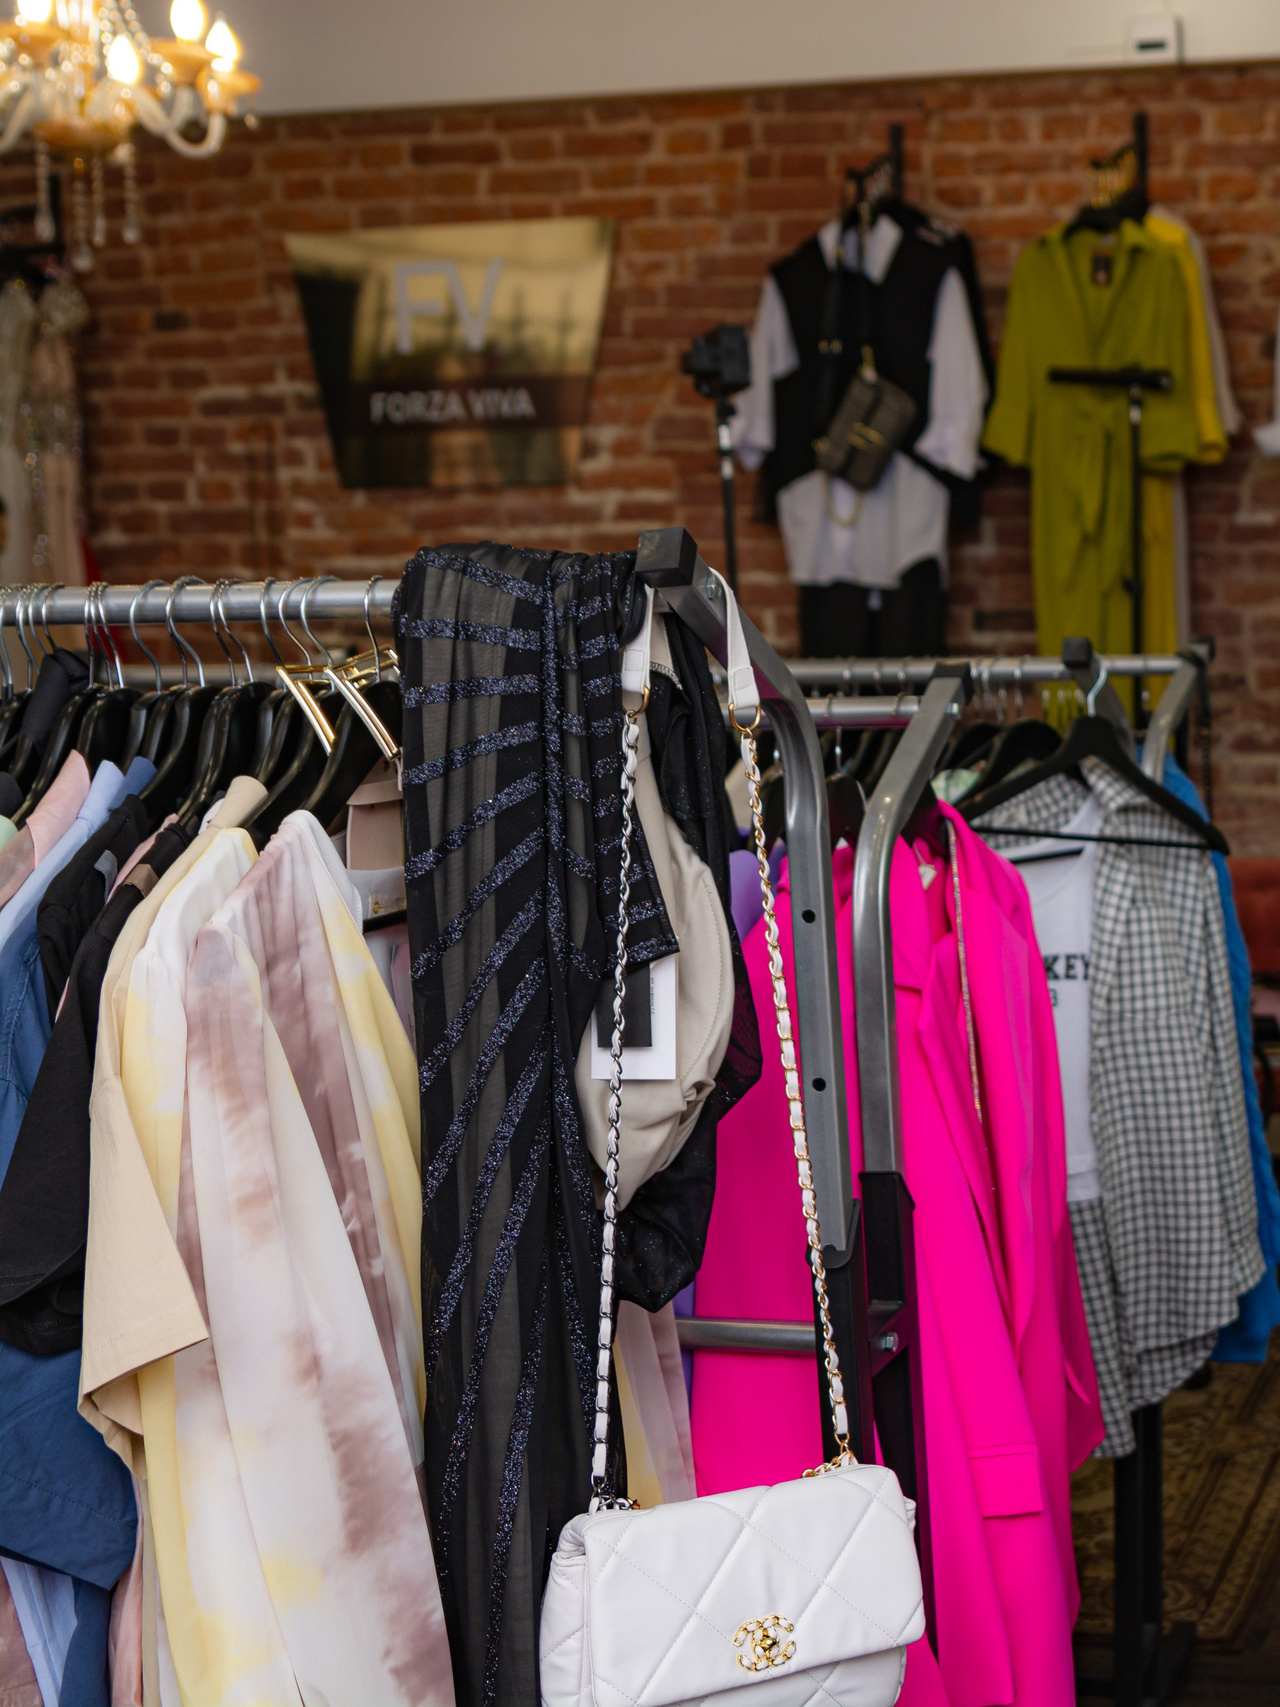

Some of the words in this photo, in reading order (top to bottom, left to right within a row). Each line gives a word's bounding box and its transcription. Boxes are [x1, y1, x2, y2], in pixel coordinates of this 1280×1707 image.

[393, 256, 504, 354] FV
[370, 390, 467, 425] FORZA
[467, 386, 537, 420] VIVA
